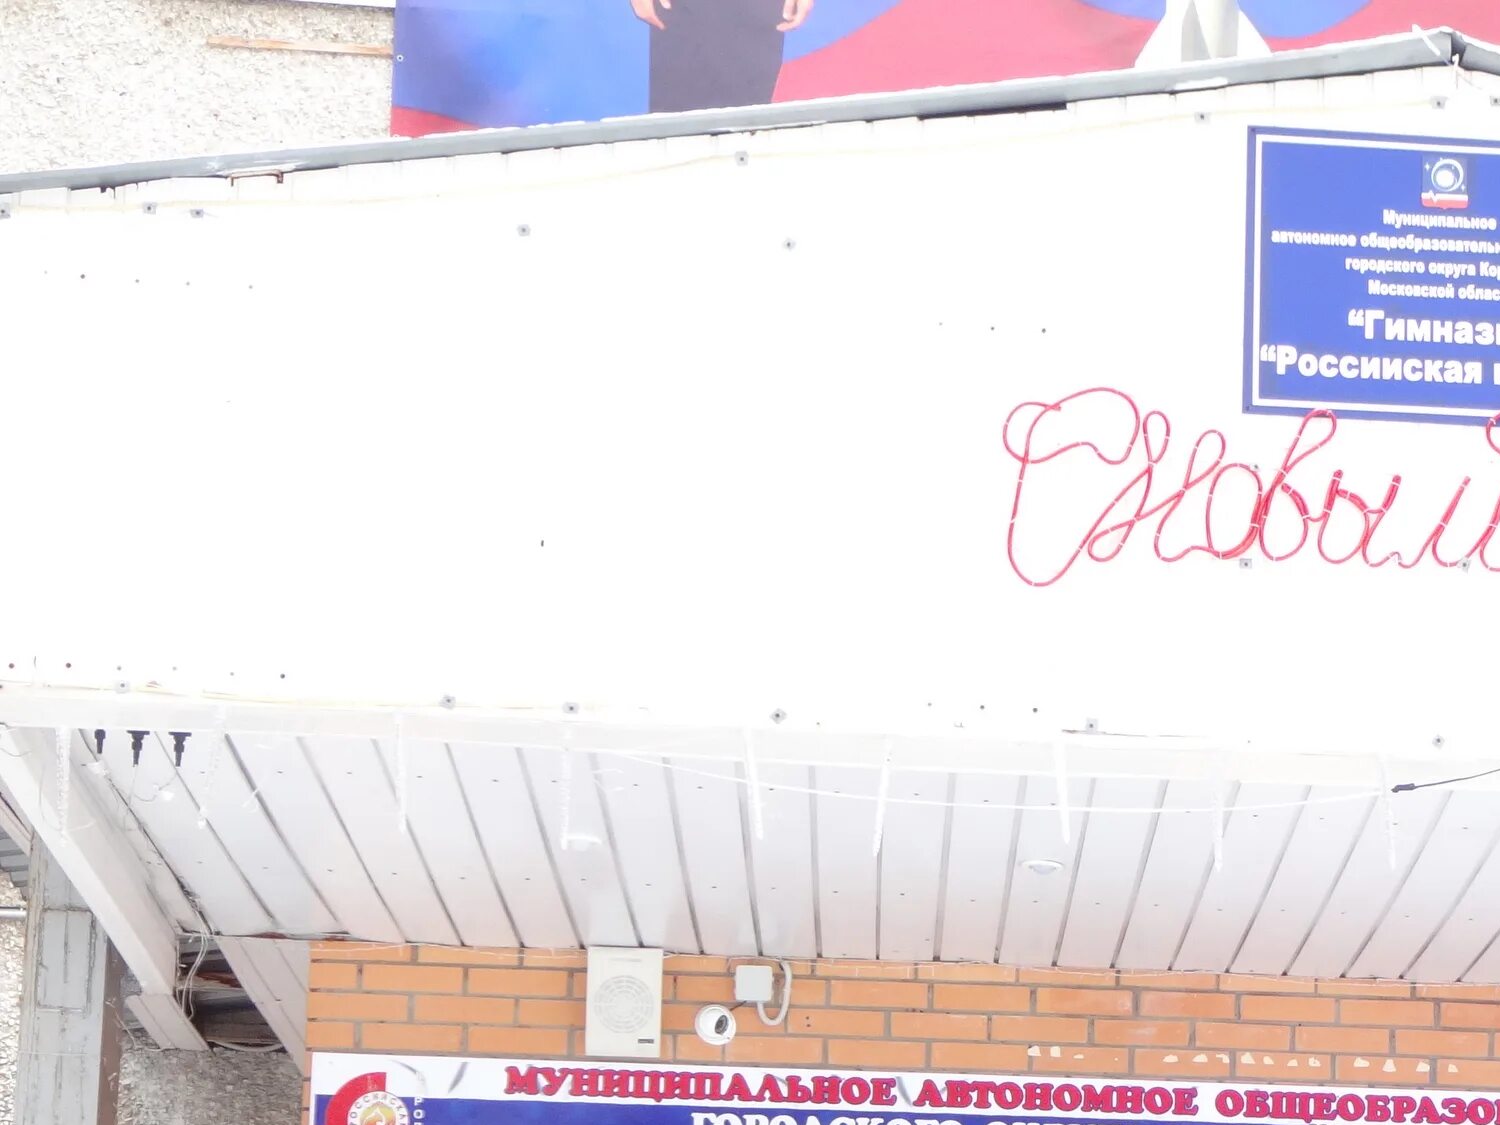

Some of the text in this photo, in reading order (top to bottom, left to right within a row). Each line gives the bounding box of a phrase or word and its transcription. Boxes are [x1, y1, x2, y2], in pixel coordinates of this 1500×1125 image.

[1382, 208, 1497, 231] Муниципальное
[1271, 230, 1357, 247] автономное
[1345, 257, 1425, 275] городского
[1428, 262, 1476, 279] округа
[1368, 279, 1455, 300] Московской
[504, 1066, 896, 1106] МУНИЦИПАЛЬНОЕ
[914, 1078, 1199, 1117] АВТОНОМНОЕ
